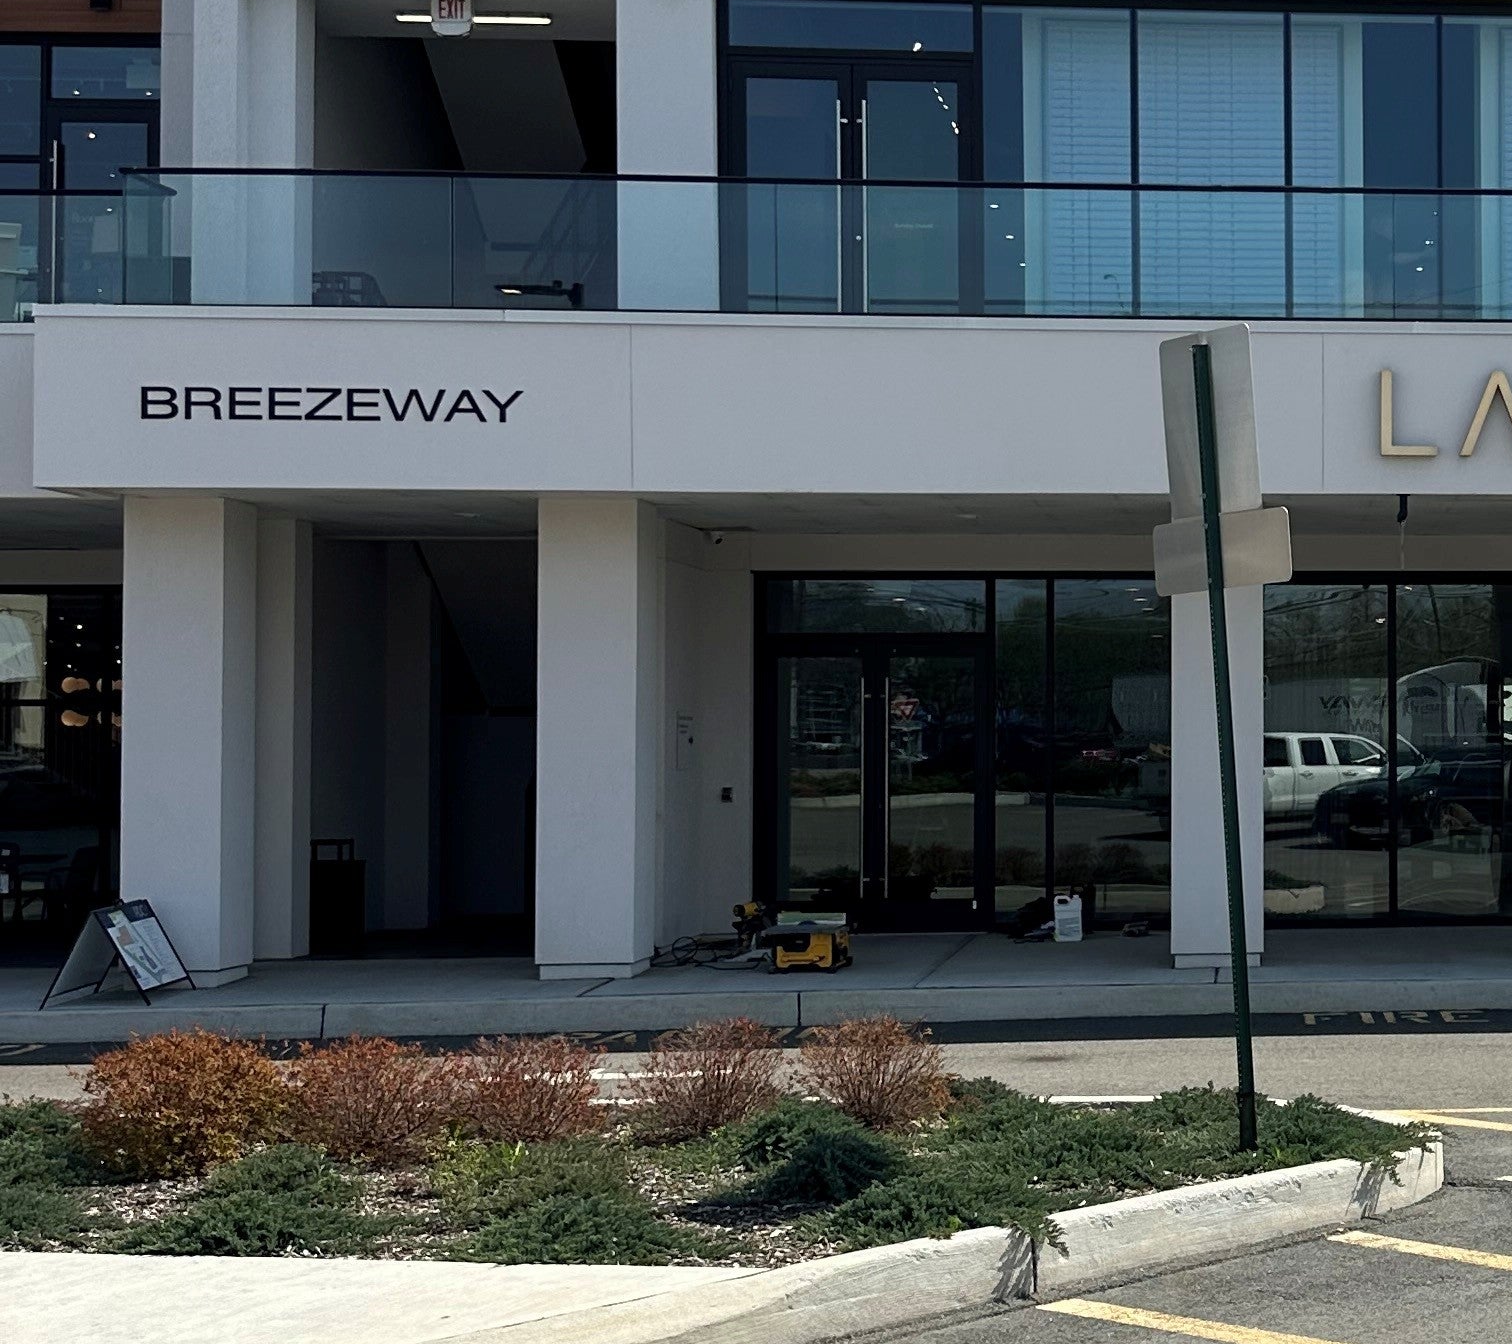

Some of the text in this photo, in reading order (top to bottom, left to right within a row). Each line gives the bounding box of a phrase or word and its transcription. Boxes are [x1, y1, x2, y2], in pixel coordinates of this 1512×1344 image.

[438, 0, 466, 19] EXIT
[139, 386, 525, 424] BREEZEWAY
[1303, 1010, 1490, 1026] FIRE
